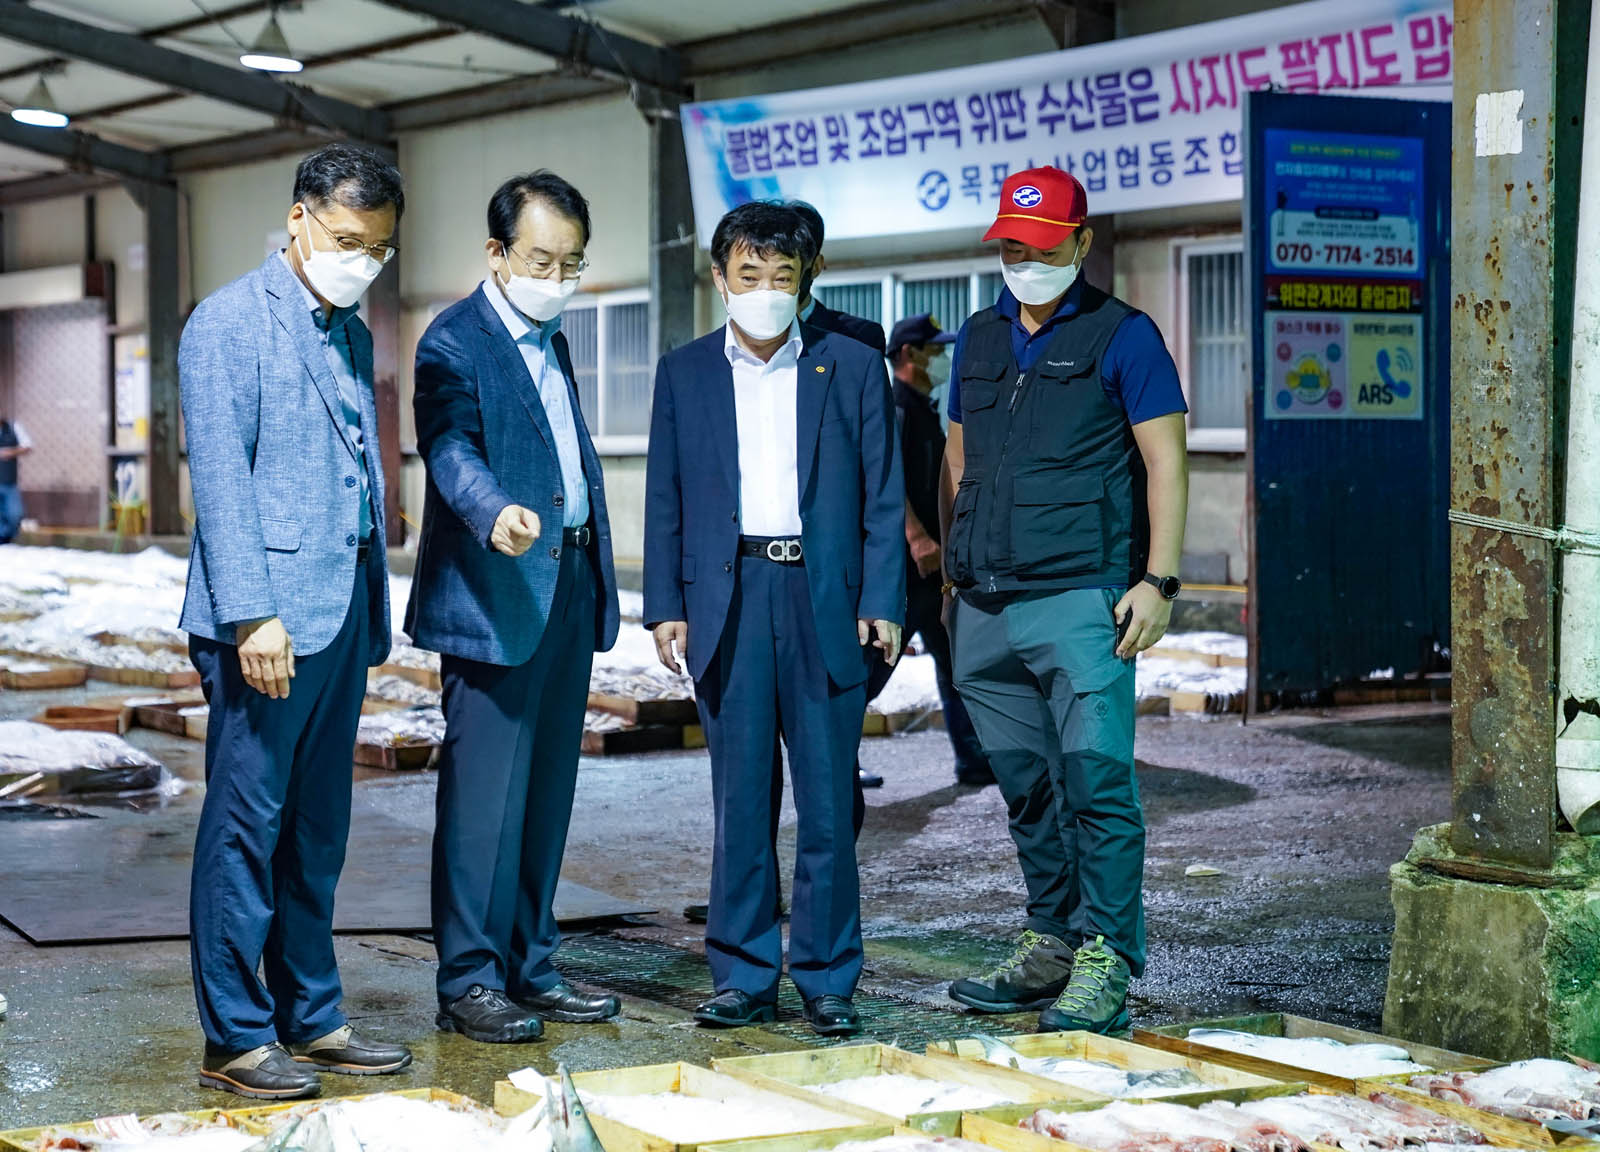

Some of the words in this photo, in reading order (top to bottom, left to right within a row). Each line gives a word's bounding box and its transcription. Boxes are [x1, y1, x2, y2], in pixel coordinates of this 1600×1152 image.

[727, 118, 818, 175] 불법조업
[824, 115, 850, 164] 및
[857, 98, 962, 158] 조업구역
[967, 88, 1027, 143] 위판
[1037, 67, 1160, 137] 수산물은
[1279, 23, 1402, 95] 팔지도
[1358, 384, 1393, 404] ARS
